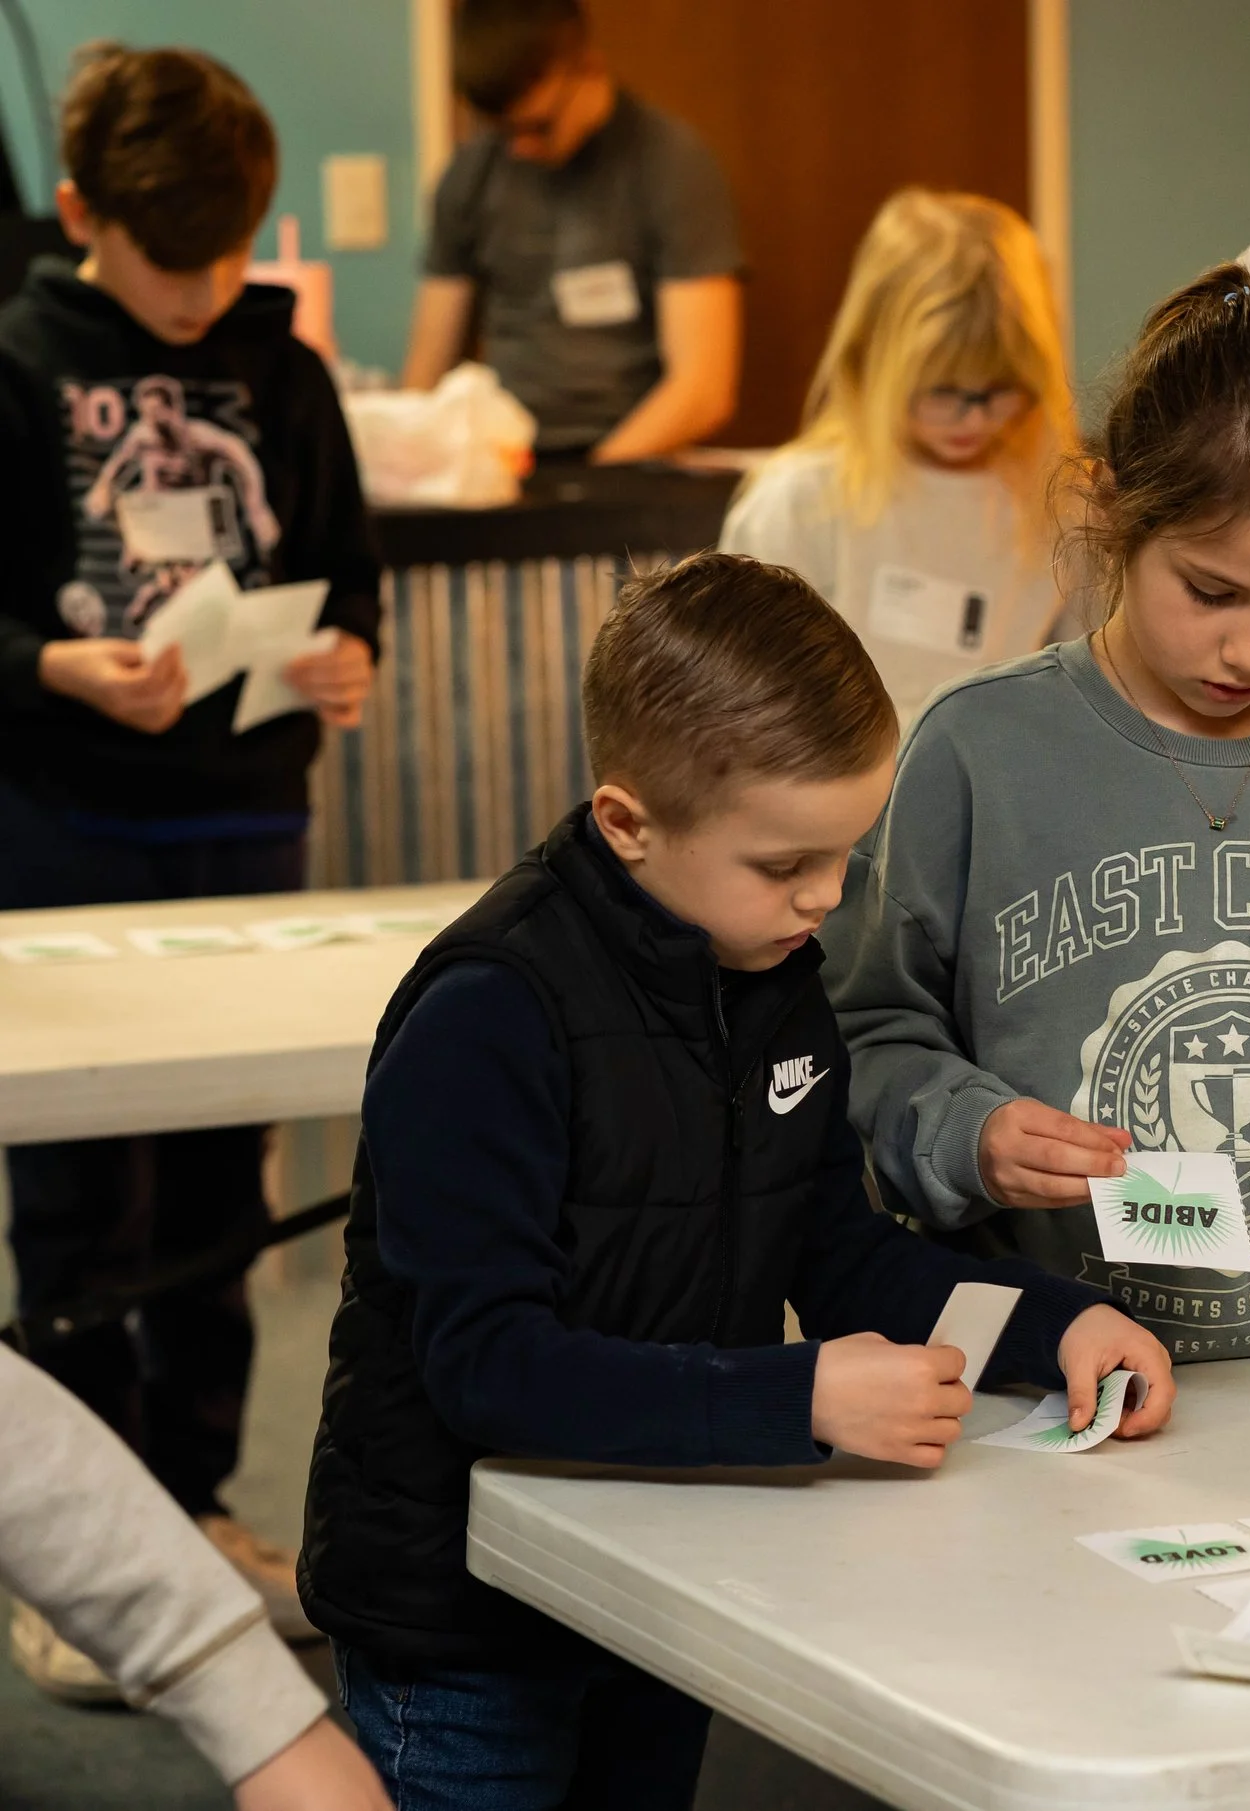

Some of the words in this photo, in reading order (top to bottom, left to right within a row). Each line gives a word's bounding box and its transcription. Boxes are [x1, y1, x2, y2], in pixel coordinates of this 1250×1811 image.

[994, 842, 1196, 1006] EAST
[1102, 978, 1196, 1093] ALL-STATE
[773, 1055, 814, 1092] NIKE
[1122, 1201, 1219, 1228] ABIDE
[1120, 1286, 1222, 1319] SPORTS
[1174, 1339, 1221, 1354] EST.
[1140, 1544, 1248, 1564] LOVED
